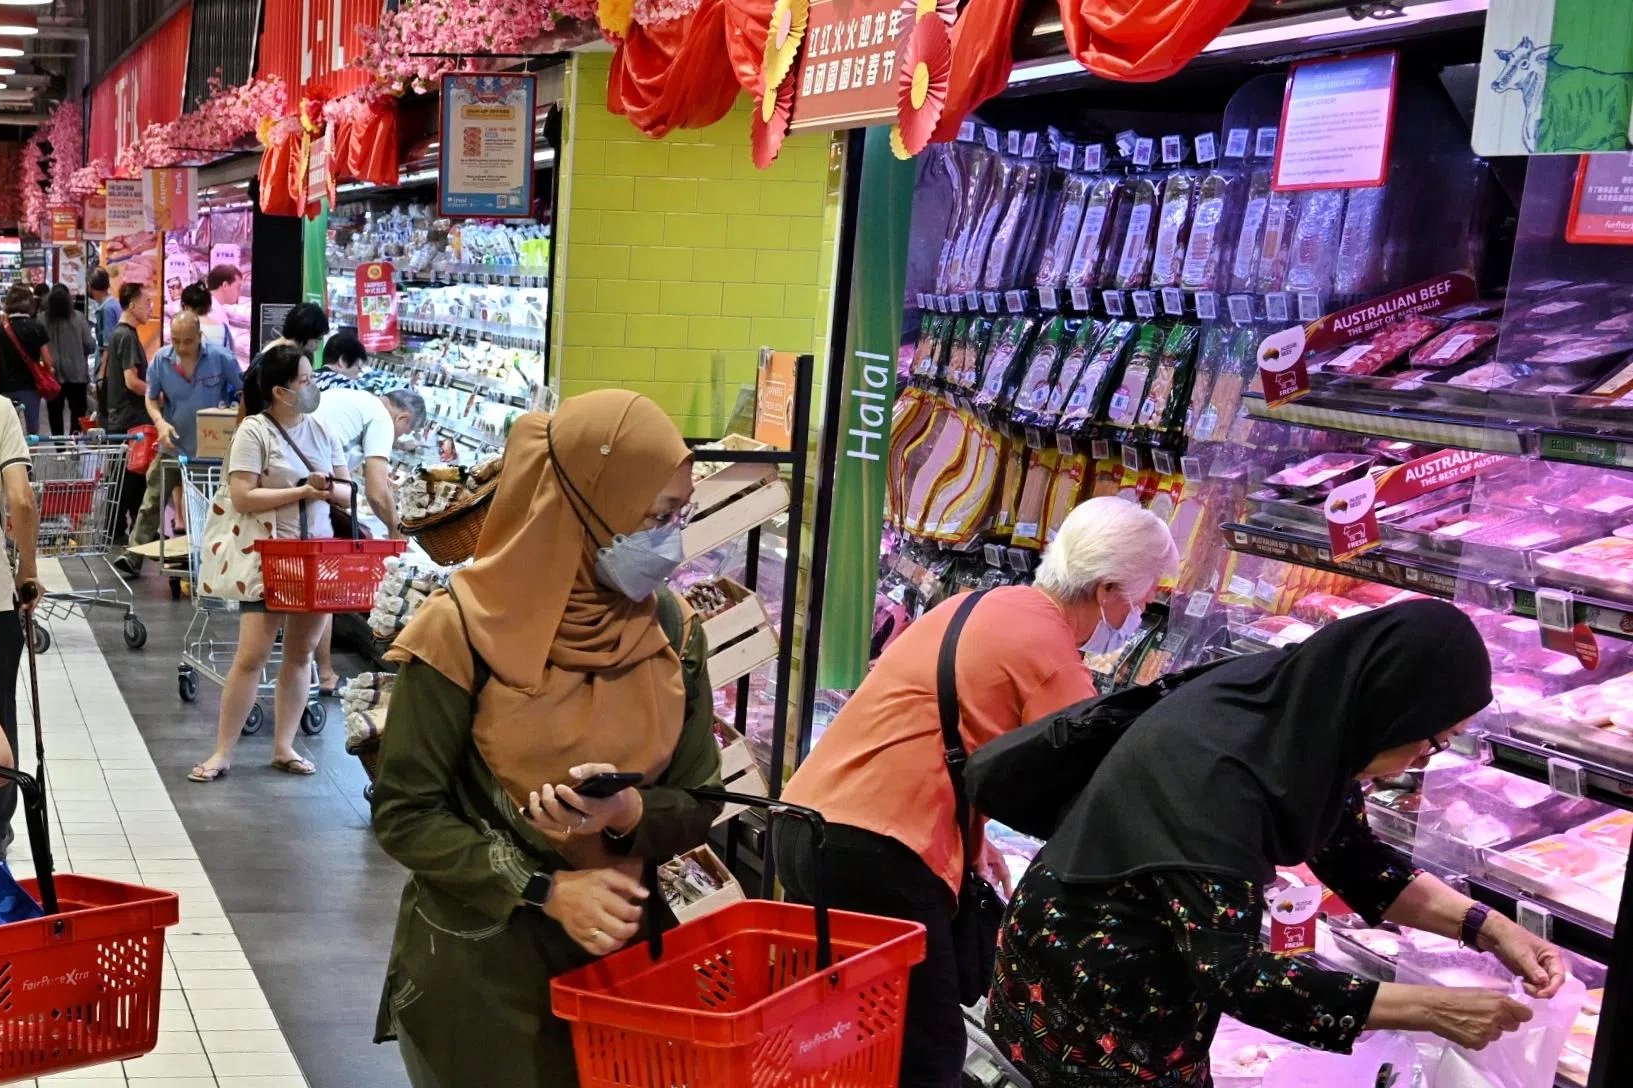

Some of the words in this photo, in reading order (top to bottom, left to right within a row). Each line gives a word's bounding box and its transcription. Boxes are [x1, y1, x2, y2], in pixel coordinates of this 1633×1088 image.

[807, 8, 902, 58] 红红火火迎龙年
[801, 49, 896, 97] 团团圆圆过春节
[1332, 291, 1417, 333] AUSTRALIAN
[1420, 279, 1453, 302] BEEF
[1346, 326, 1363, 338] THE
[1363, 319, 1383, 334] BEST
[1397, 298, 1442, 318] AUSTRALIA
[846, 350, 890, 461] Halal
[1279, 385, 1299, 397] FRESH
[1404, 448, 1487, 484] AUSTRALIA
[1575, 441, 1607, 459] Poultry
[1420, 476, 1436, 488] THE
[1437, 469, 1459, 485] BEST
[1460, 465, 1472, 475] OF
[1347, 537, 1369, 549] FRESH
